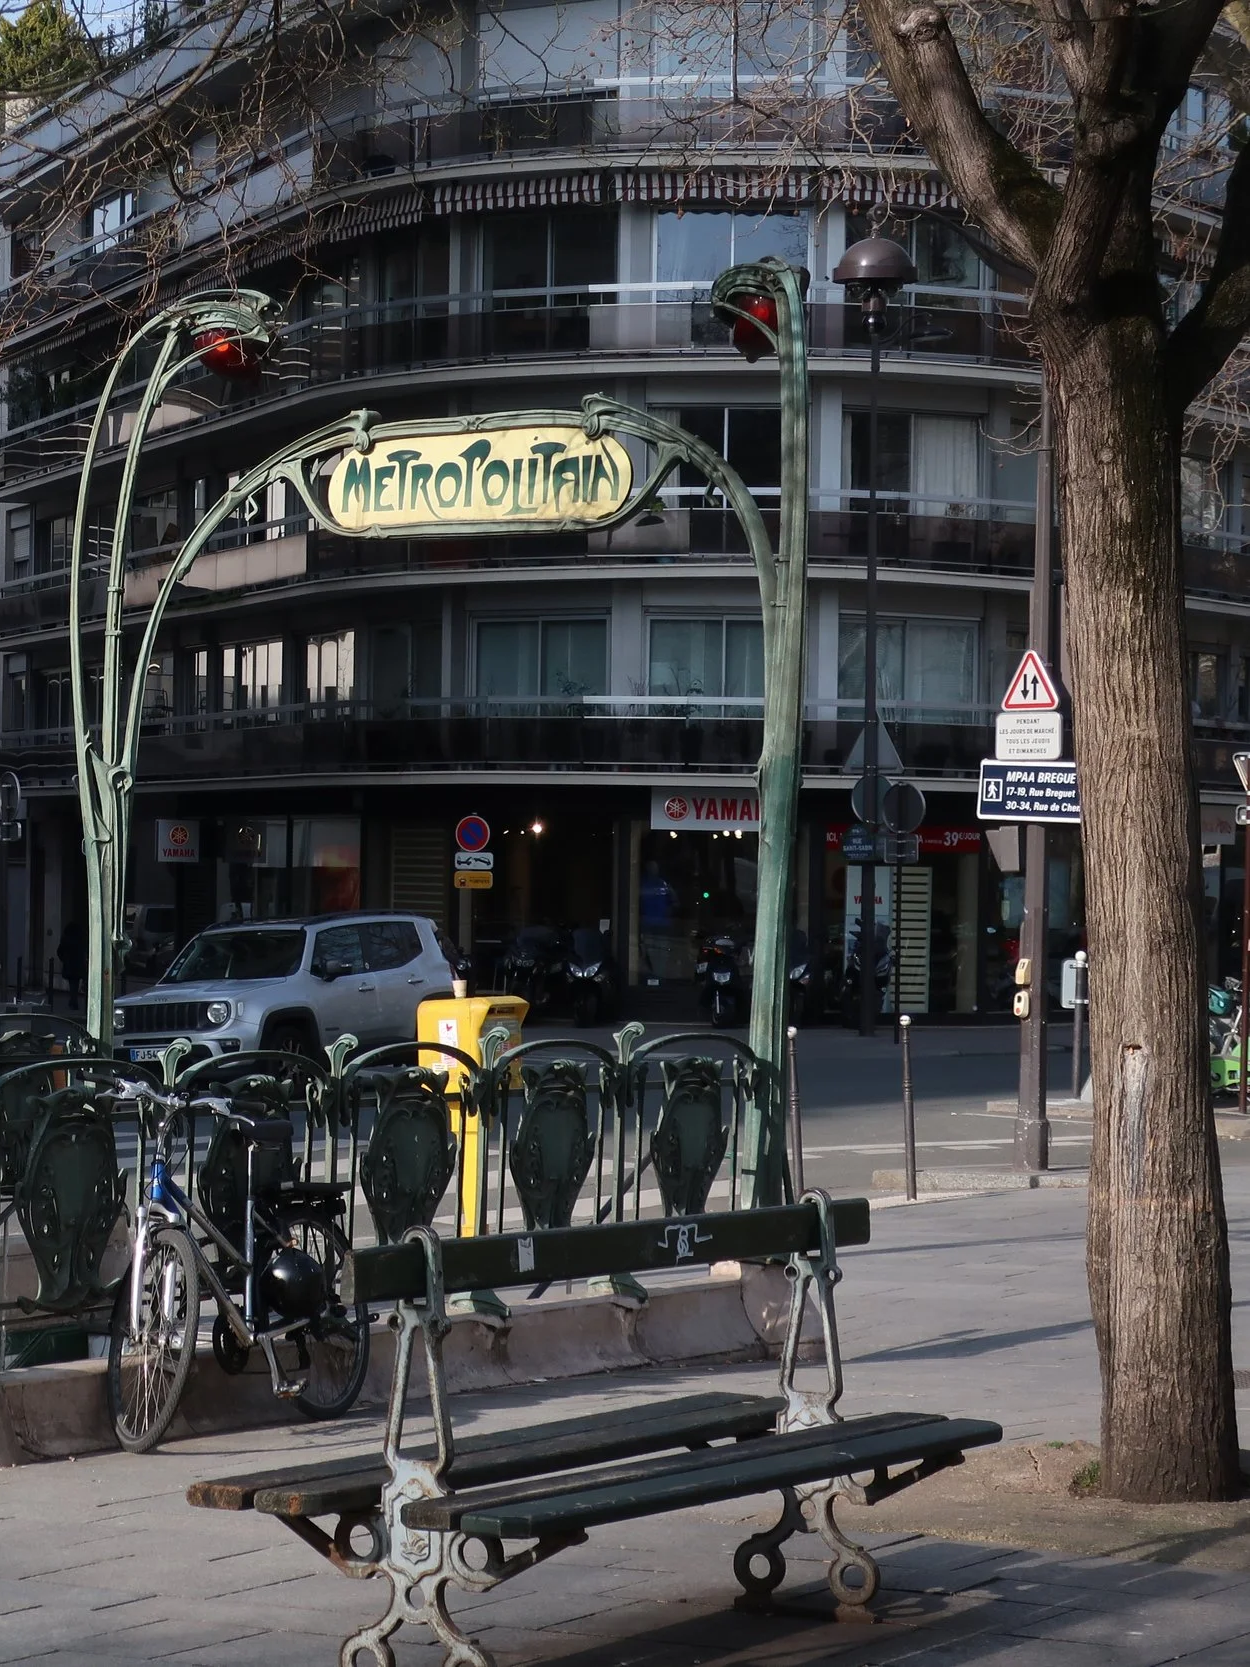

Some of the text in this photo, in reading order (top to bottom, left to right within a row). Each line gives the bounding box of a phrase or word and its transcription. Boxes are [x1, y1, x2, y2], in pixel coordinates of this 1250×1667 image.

[340, 437, 620, 520] METROPOLITAIN
[1006, 771, 1077, 785] MPAA BREGUE
[1006, 786, 1076, 800] 17-19, Rue Breguet
[692, 797, 760, 821] YAMA
[1005, 801, 1032, 812] 30-34,
[1033, 802, 1049, 811] Rue
[1050, 803, 1060, 811] de
[162, 848, 196, 858] YAMAHA
[853, 895, 883, 905] YAHA
